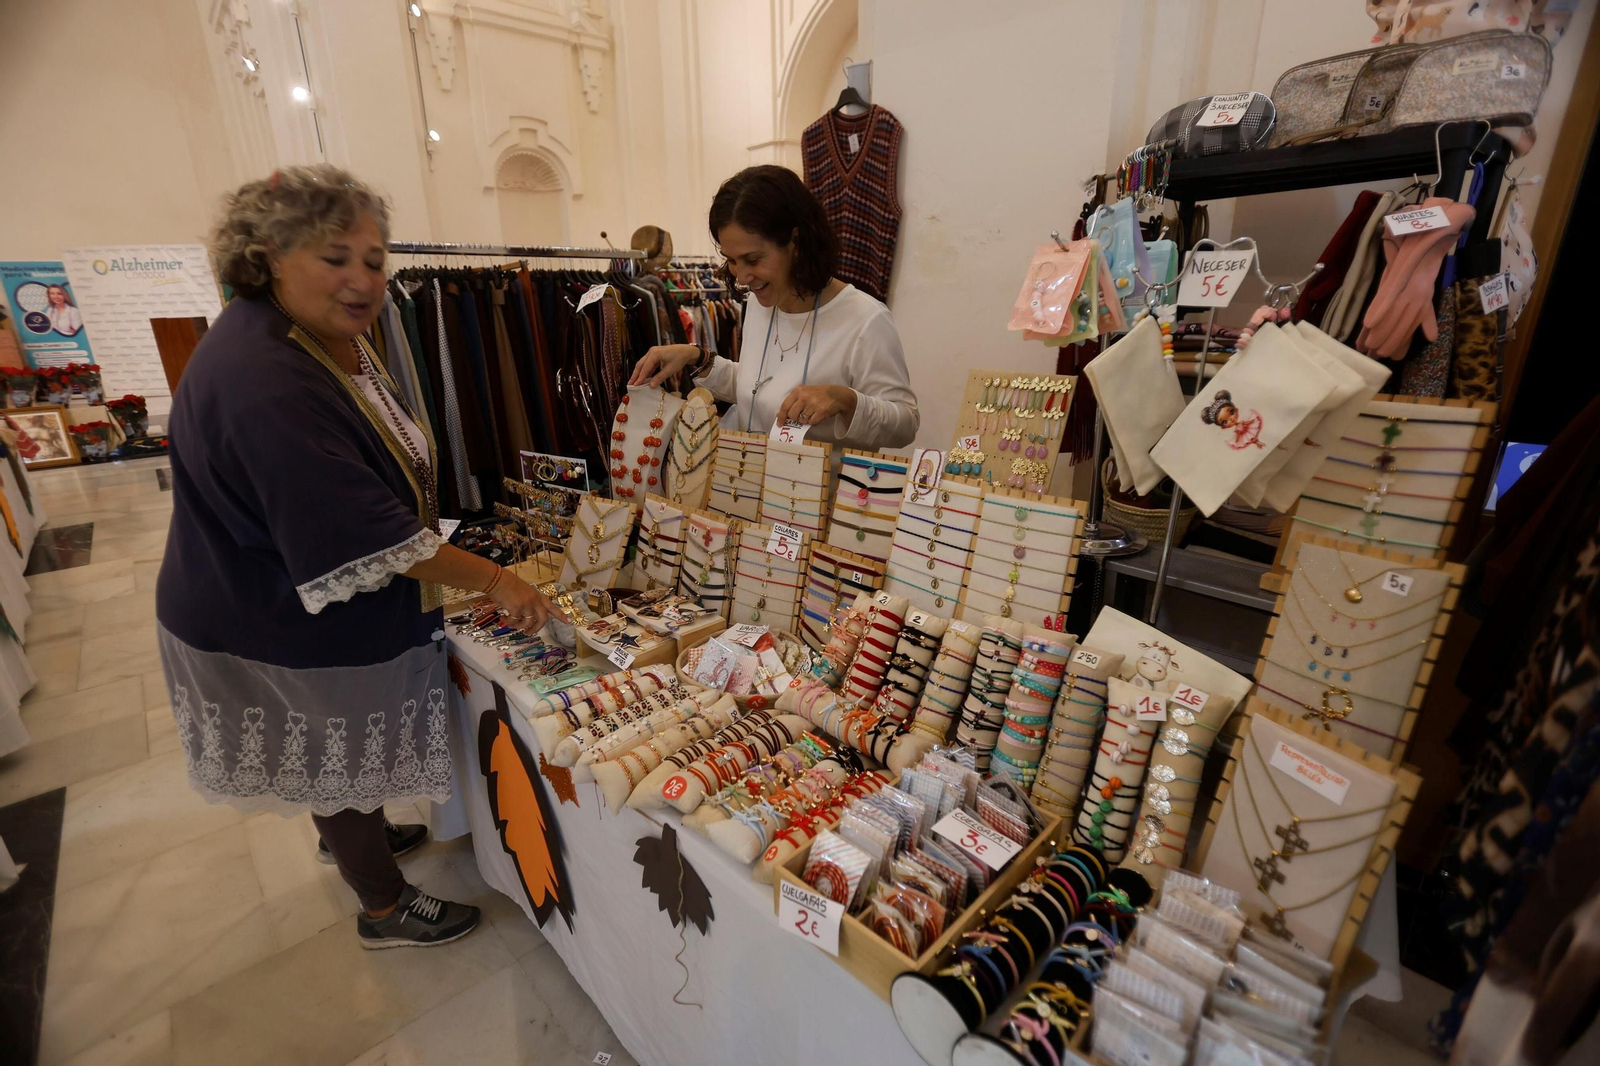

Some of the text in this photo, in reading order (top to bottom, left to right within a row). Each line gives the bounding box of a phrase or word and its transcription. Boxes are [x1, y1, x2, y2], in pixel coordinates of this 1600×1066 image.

[1214, 94, 1249, 102] CONJUNTO
[1369, 97, 1381, 108] 5€
[1213, 111, 1234, 124] 5€
[1392, 210, 1434, 223] GUANTES
[1411, 220, 1433, 229] 8€
[110, 257, 183, 272] Alzheimer
[1191, 258, 1247, 274] NECESER
[125, 270, 166, 280] Córdoba
[1201, 275, 1230, 297] 5€
[779, 427, 794, 443] 5€
[965, 438, 978, 450] 8€
[774, 525, 799, 538] COLLARES
[774, 536, 793, 559] 5€
[1390, 574, 1408, 592] 5€
[1077, 652, 1098, 665] 2'50
[1139, 696, 1162, 714] 1€
[1175, 688, 1203, 706] 1€
[665, 779, 684, 797] 2€
[954, 812, 1013, 848] CUELGAFAS
[960, 829, 989, 856] 3€
[782, 883, 828, 913] CUELGAFAS
[795, 909, 820, 939] 2€
